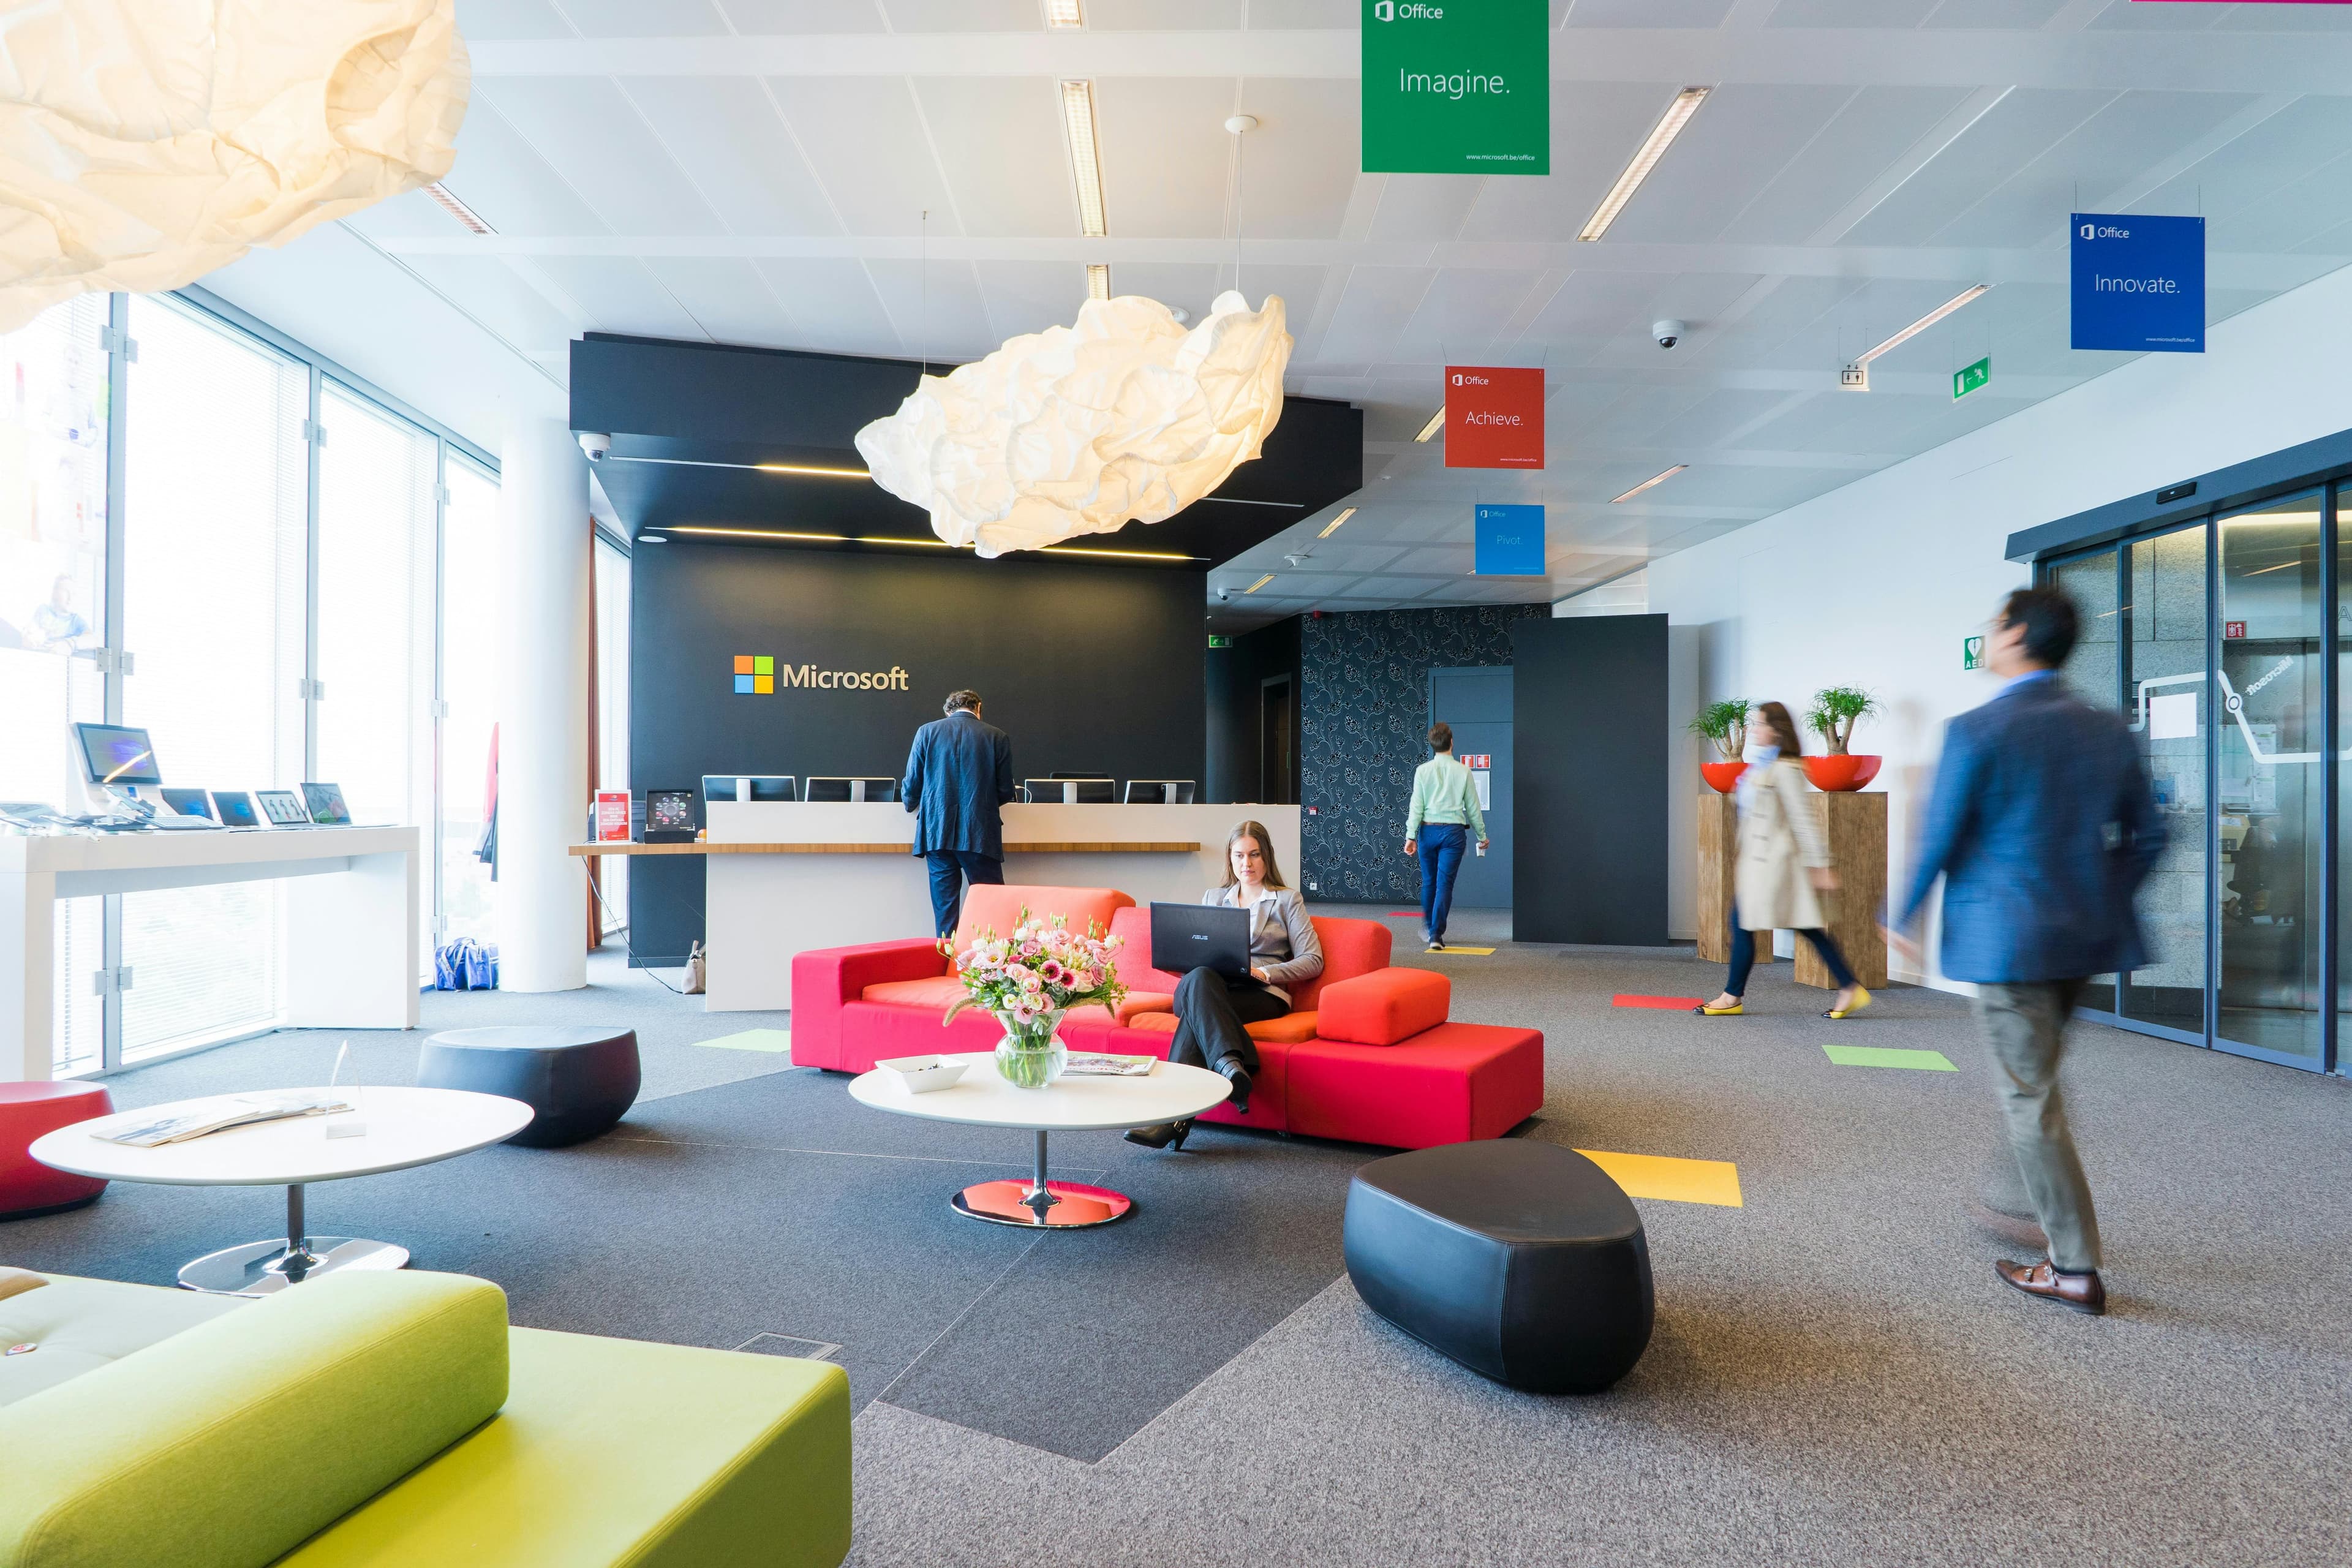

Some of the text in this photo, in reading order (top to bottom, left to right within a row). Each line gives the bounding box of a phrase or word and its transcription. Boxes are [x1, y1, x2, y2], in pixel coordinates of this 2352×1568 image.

[1399, 4, 1443, 19] Office
[1401, 68, 1510, 100] Imagine.
[2098, 227, 2130, 238] Office
[2095, 274, 2180, 293] Innovate.
[1464, 375, 1489, 385] Office
[1465, 411, 1524, 426] Achieve.
[1496, 535, 1523, 545] Pivot.
[1966, 658, 1984, 669] AED
[783, 664, 909, 691] Microsoft
